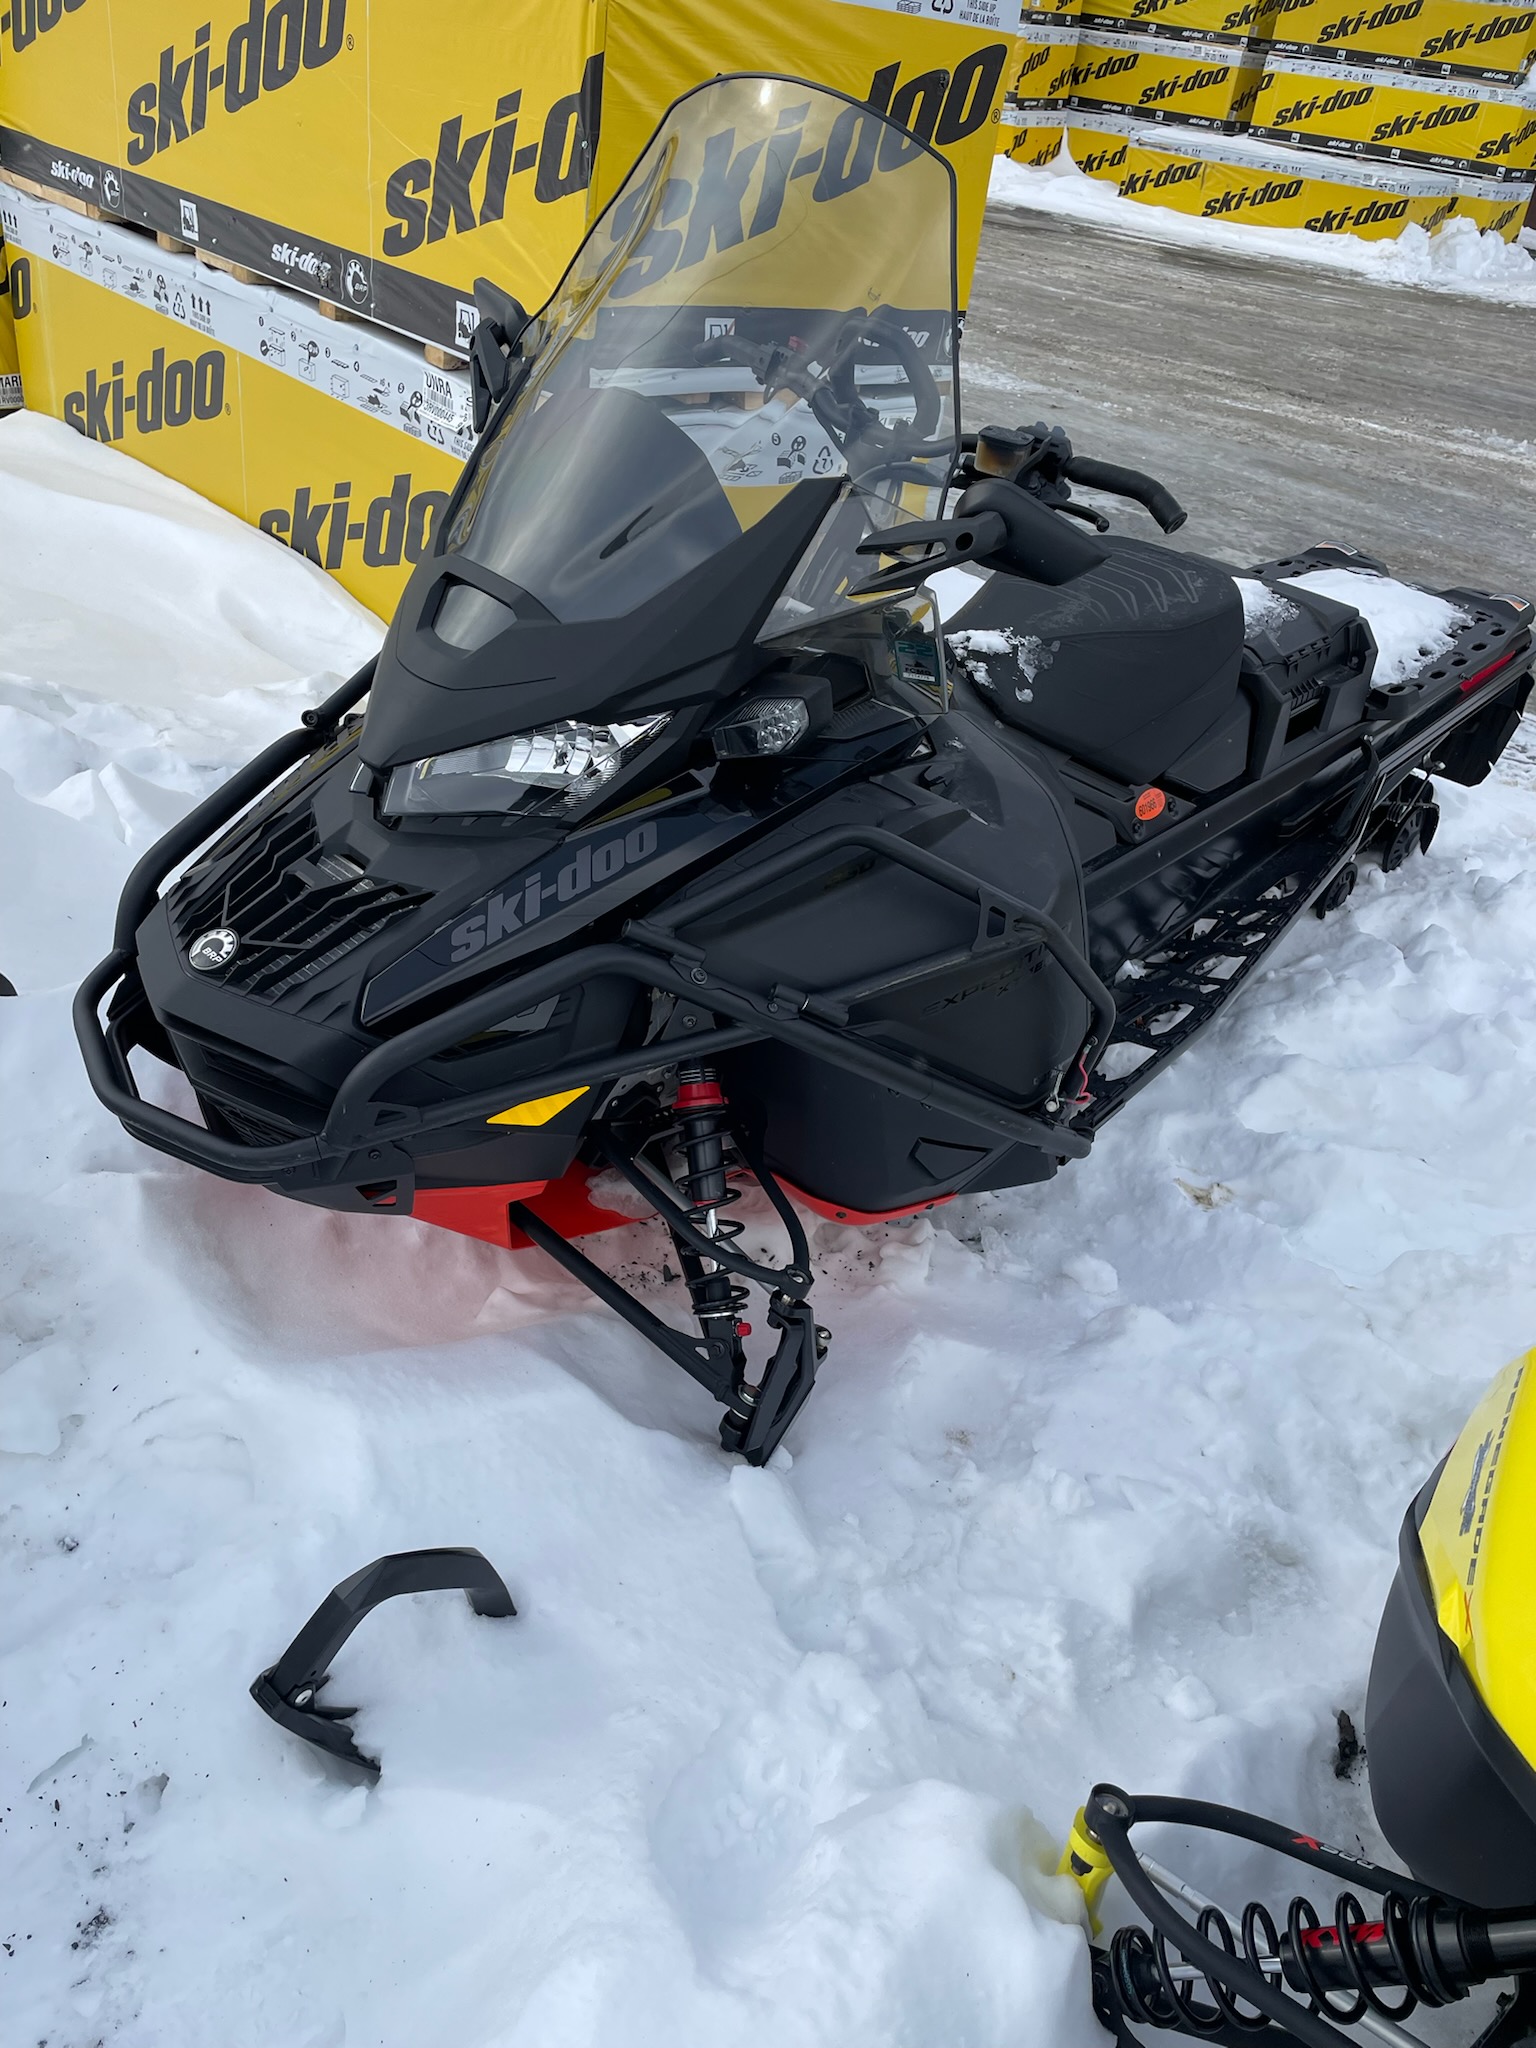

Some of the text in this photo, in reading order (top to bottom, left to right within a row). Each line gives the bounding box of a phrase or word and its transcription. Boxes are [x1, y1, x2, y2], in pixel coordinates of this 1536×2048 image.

[1317, 0, 1424, 43] ski-doo
[1420, 12, 1536, 57] ski-doo
[1138, 66, 1230, 104] ski-doo
[1272, 86, 1374, 126] ski-doo
[1371, 102, 1480, 141] ski-doo
[382, 51, 604, 257] ski-d
[608, 43, 1007, 299] ski-doo
[1201, 180, 1303, 217] ski-doo
[260, 473, 451, 570] ski-do
[450, 821, 658, 963] ski-doo
[202, 947, 223, 962] BRP
[1467, 1366, 1524, 1586] RENEGADE
